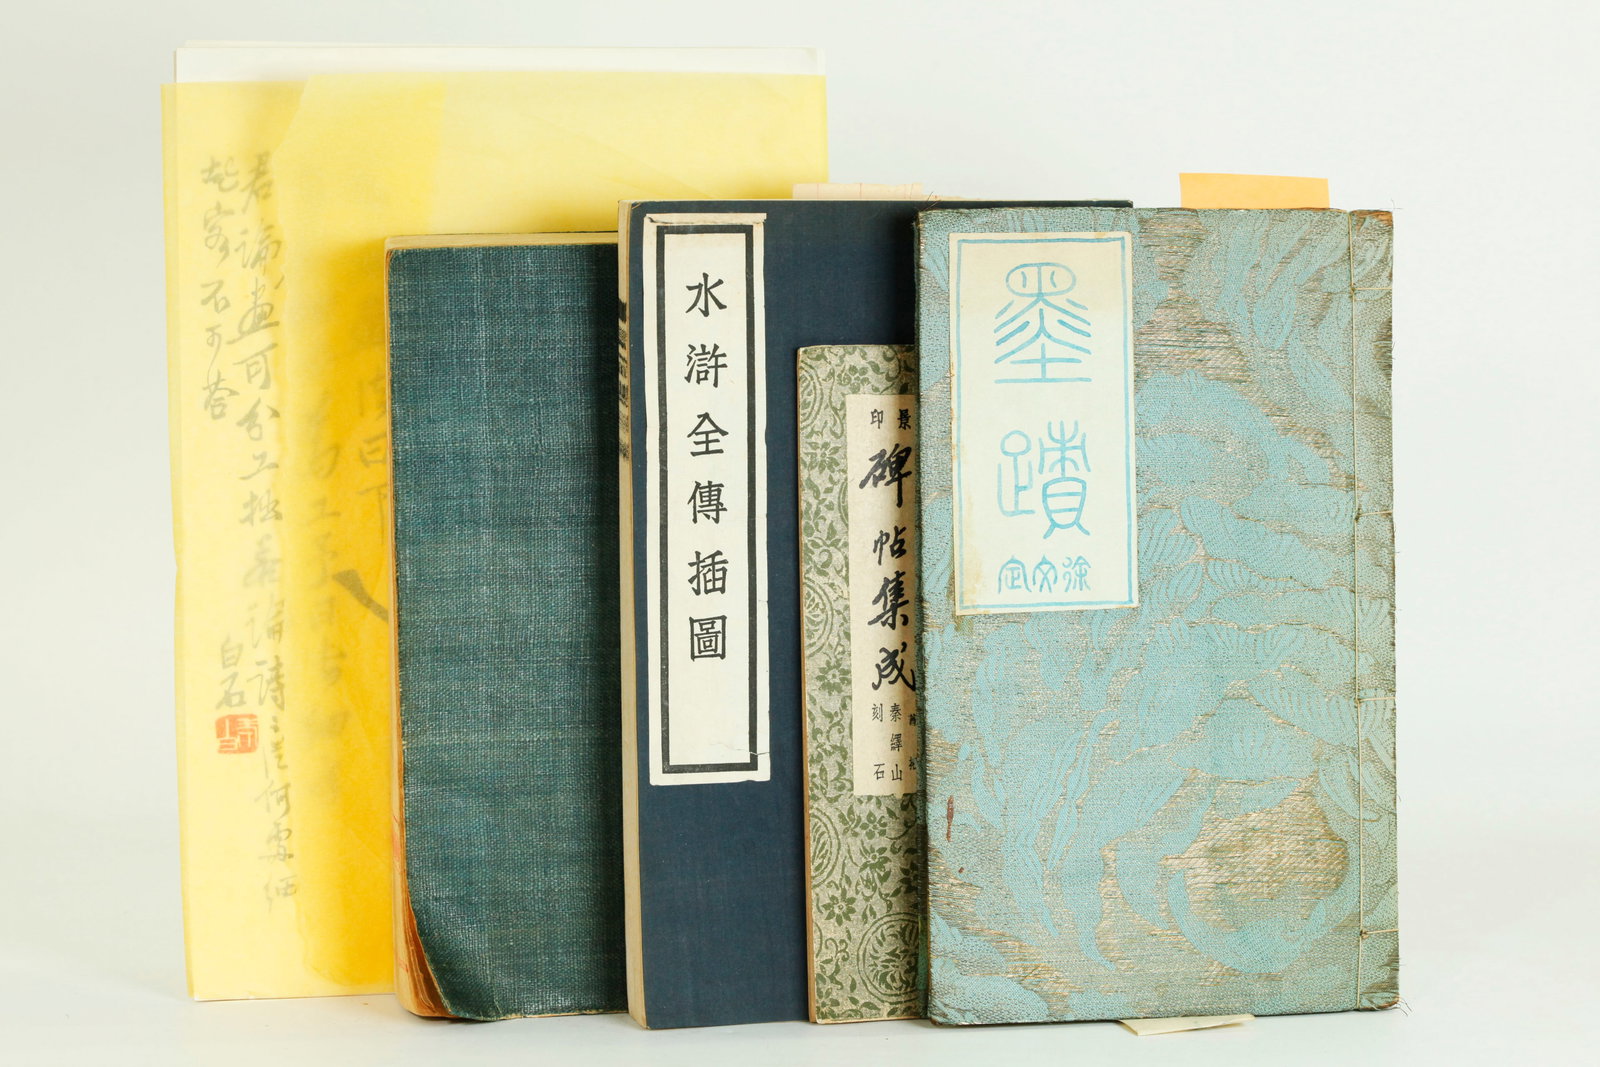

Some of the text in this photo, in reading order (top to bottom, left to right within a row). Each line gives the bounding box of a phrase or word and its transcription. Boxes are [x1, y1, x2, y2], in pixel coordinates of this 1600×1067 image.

[684, 272, 729, 661] 水滸全傳插圖
[859, 443, 915, 692] 碑帖集成
